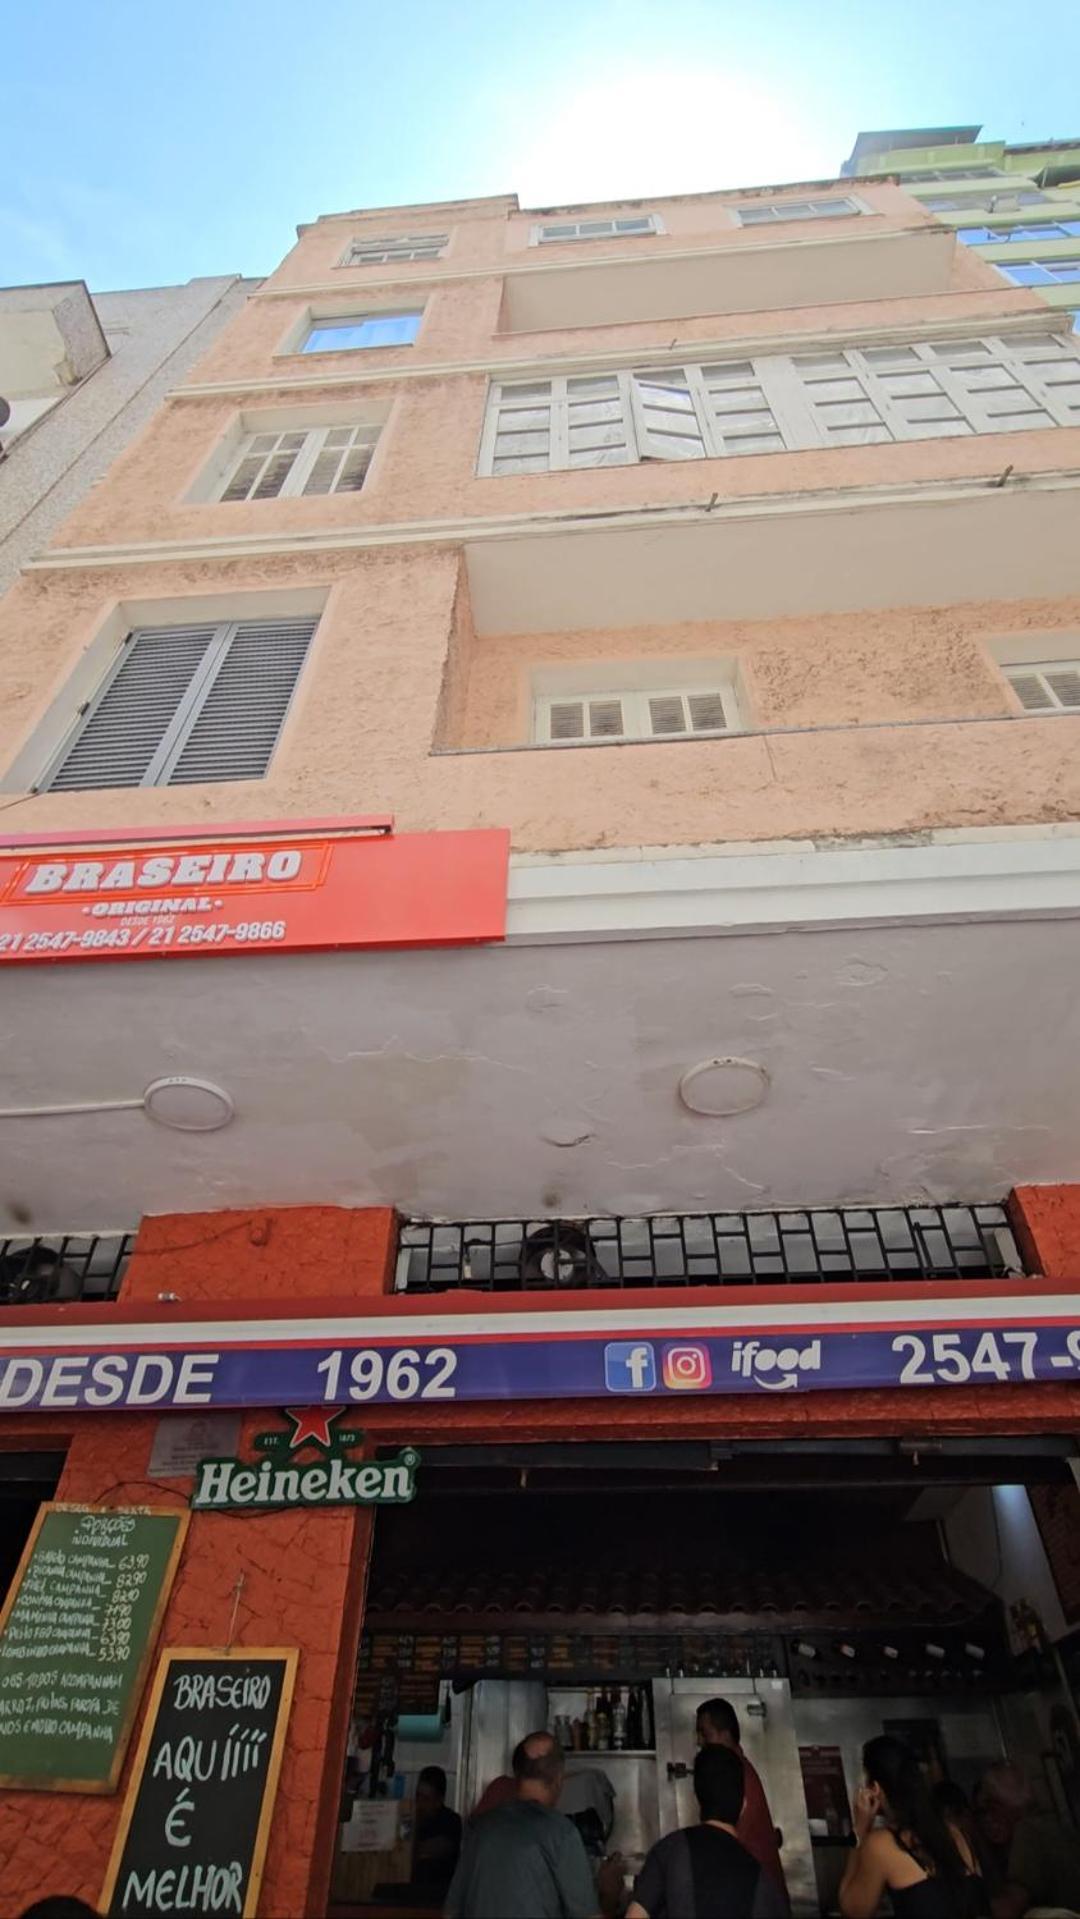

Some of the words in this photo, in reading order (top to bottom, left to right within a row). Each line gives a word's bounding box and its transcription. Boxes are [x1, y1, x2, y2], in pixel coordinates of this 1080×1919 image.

[26, 850, 302, 893] BRASEIRO
[147, 926, 176, 946] 21
[178, 921, 286, 944] 2547-9866
[0, 1354, 219, 1407] DESDE
[316, 1348, 457, 1400] 1962
[731, 1340, 821, 1377] ifood
[196, 1459, 411, 1504] Heineken
[174, 1674, 271, 1711] BRASEIRO
[165, 1787, 195, 1847] É
[122, 1861, 243, 1913] MELHOR
